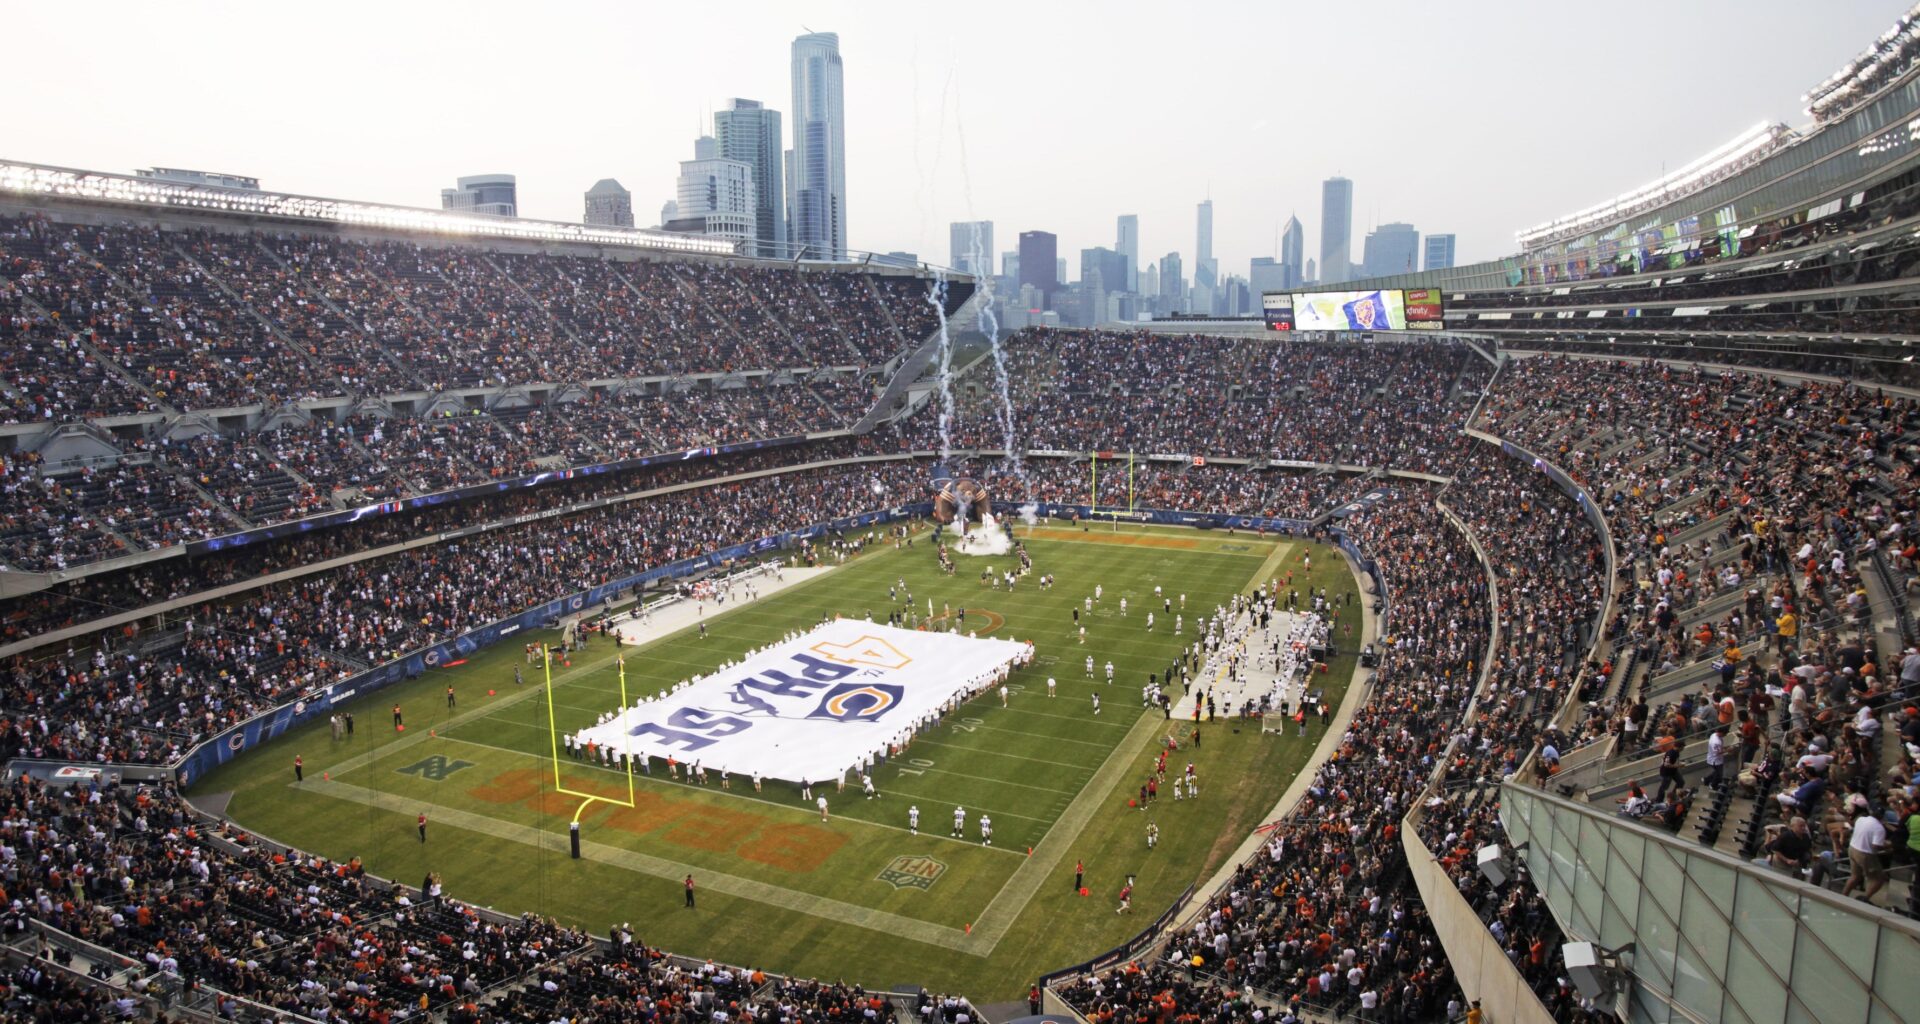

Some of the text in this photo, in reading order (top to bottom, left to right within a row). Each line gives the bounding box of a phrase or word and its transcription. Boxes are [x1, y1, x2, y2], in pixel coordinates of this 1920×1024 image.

[1406, 306, 1429, 316] xfinity
[515, 508, 561, 523] MEDIA DECK
[951, 717, 985, 734] 20
[897, 758, 936, 777] 10
[897, 856, 941, 878] NFL
